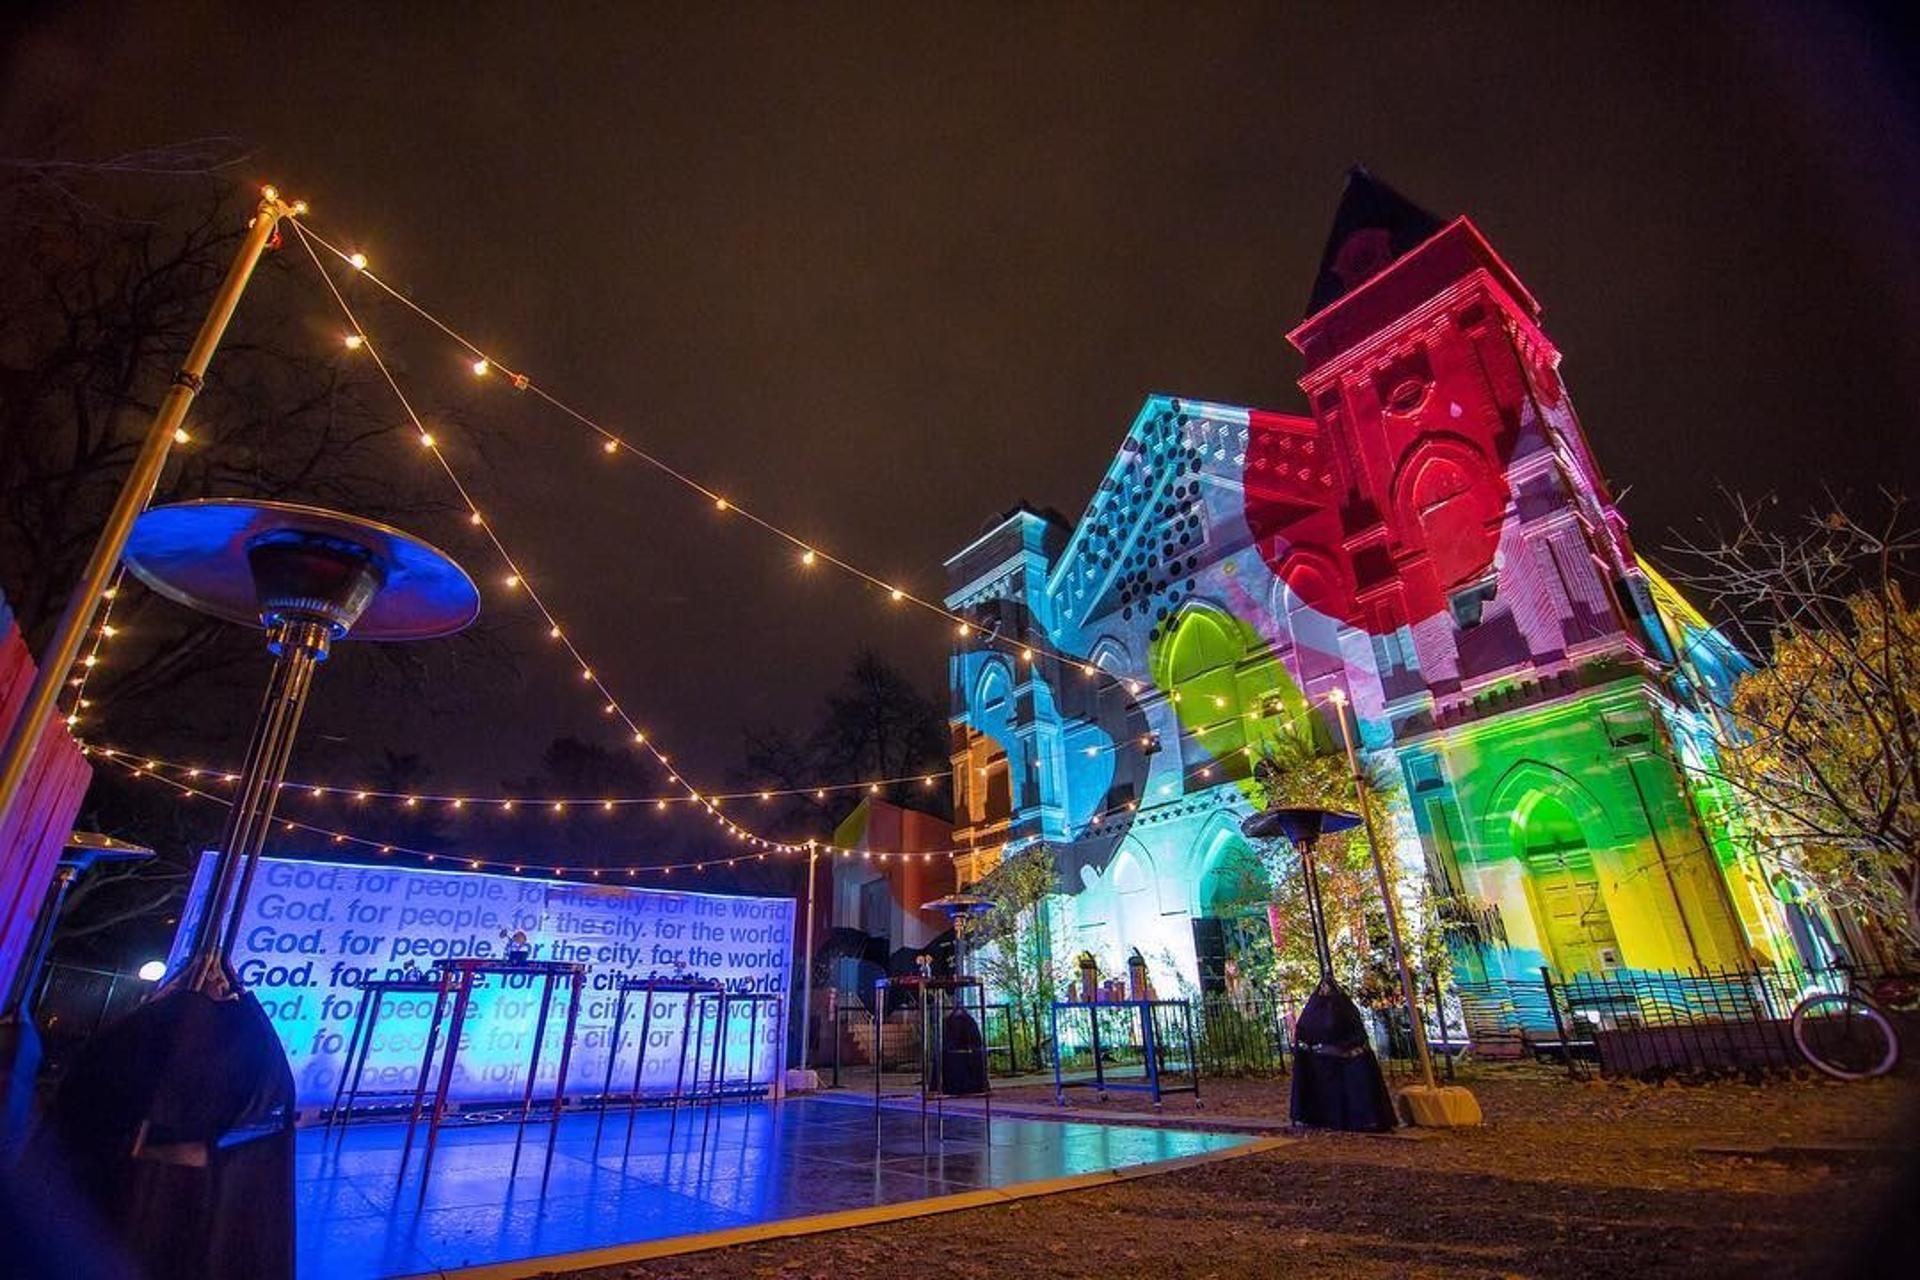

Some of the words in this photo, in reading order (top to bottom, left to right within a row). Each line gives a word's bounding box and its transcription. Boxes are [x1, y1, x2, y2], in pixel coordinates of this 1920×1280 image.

[266, 864, 343, 890] God.
[356, 868, 399, 893] for
[405, 877, 508, 903] people.
[658, 896, 687, 914] for
[694, 898, 726, 917] the
[732, 900, 791, 920] world.
[257, 894, 335, 922] God.
[347, 898, 392, 923] for
[398, 905, 502, 932] people.
[512, 908, 550, 931] for
[556, 911, 595, 934] the
[602, 915, 647, 941] city.
[654, 918, 686, 939] for
[691, 921, 725, 941] the
[730, 924, 790, 943] world.
[247, 926, 326, 953] God.
[339, 929, 385, 955] for
[389, 934, 497, 962] people.
[550, 939, 591, 961] the
[596, 942, 643, 969] city.
[652, 944, 683, 964] for
[688, 946, 722, 967] the
[728, 948, 789, 967] world.
[238, 959, 318, 987] God.
[329, 962, 377, 987] for
[261, 994, 307, 1021] od.
[494, 996, 535, 1020] for
[652, 1002, 678, 1019] or
[311, 1028, 348, 1055] fo
[649, 1031, 674, 1048] or
[301, 1062, 336, 1089] fo
[646, 1059, 671, 1076] or
